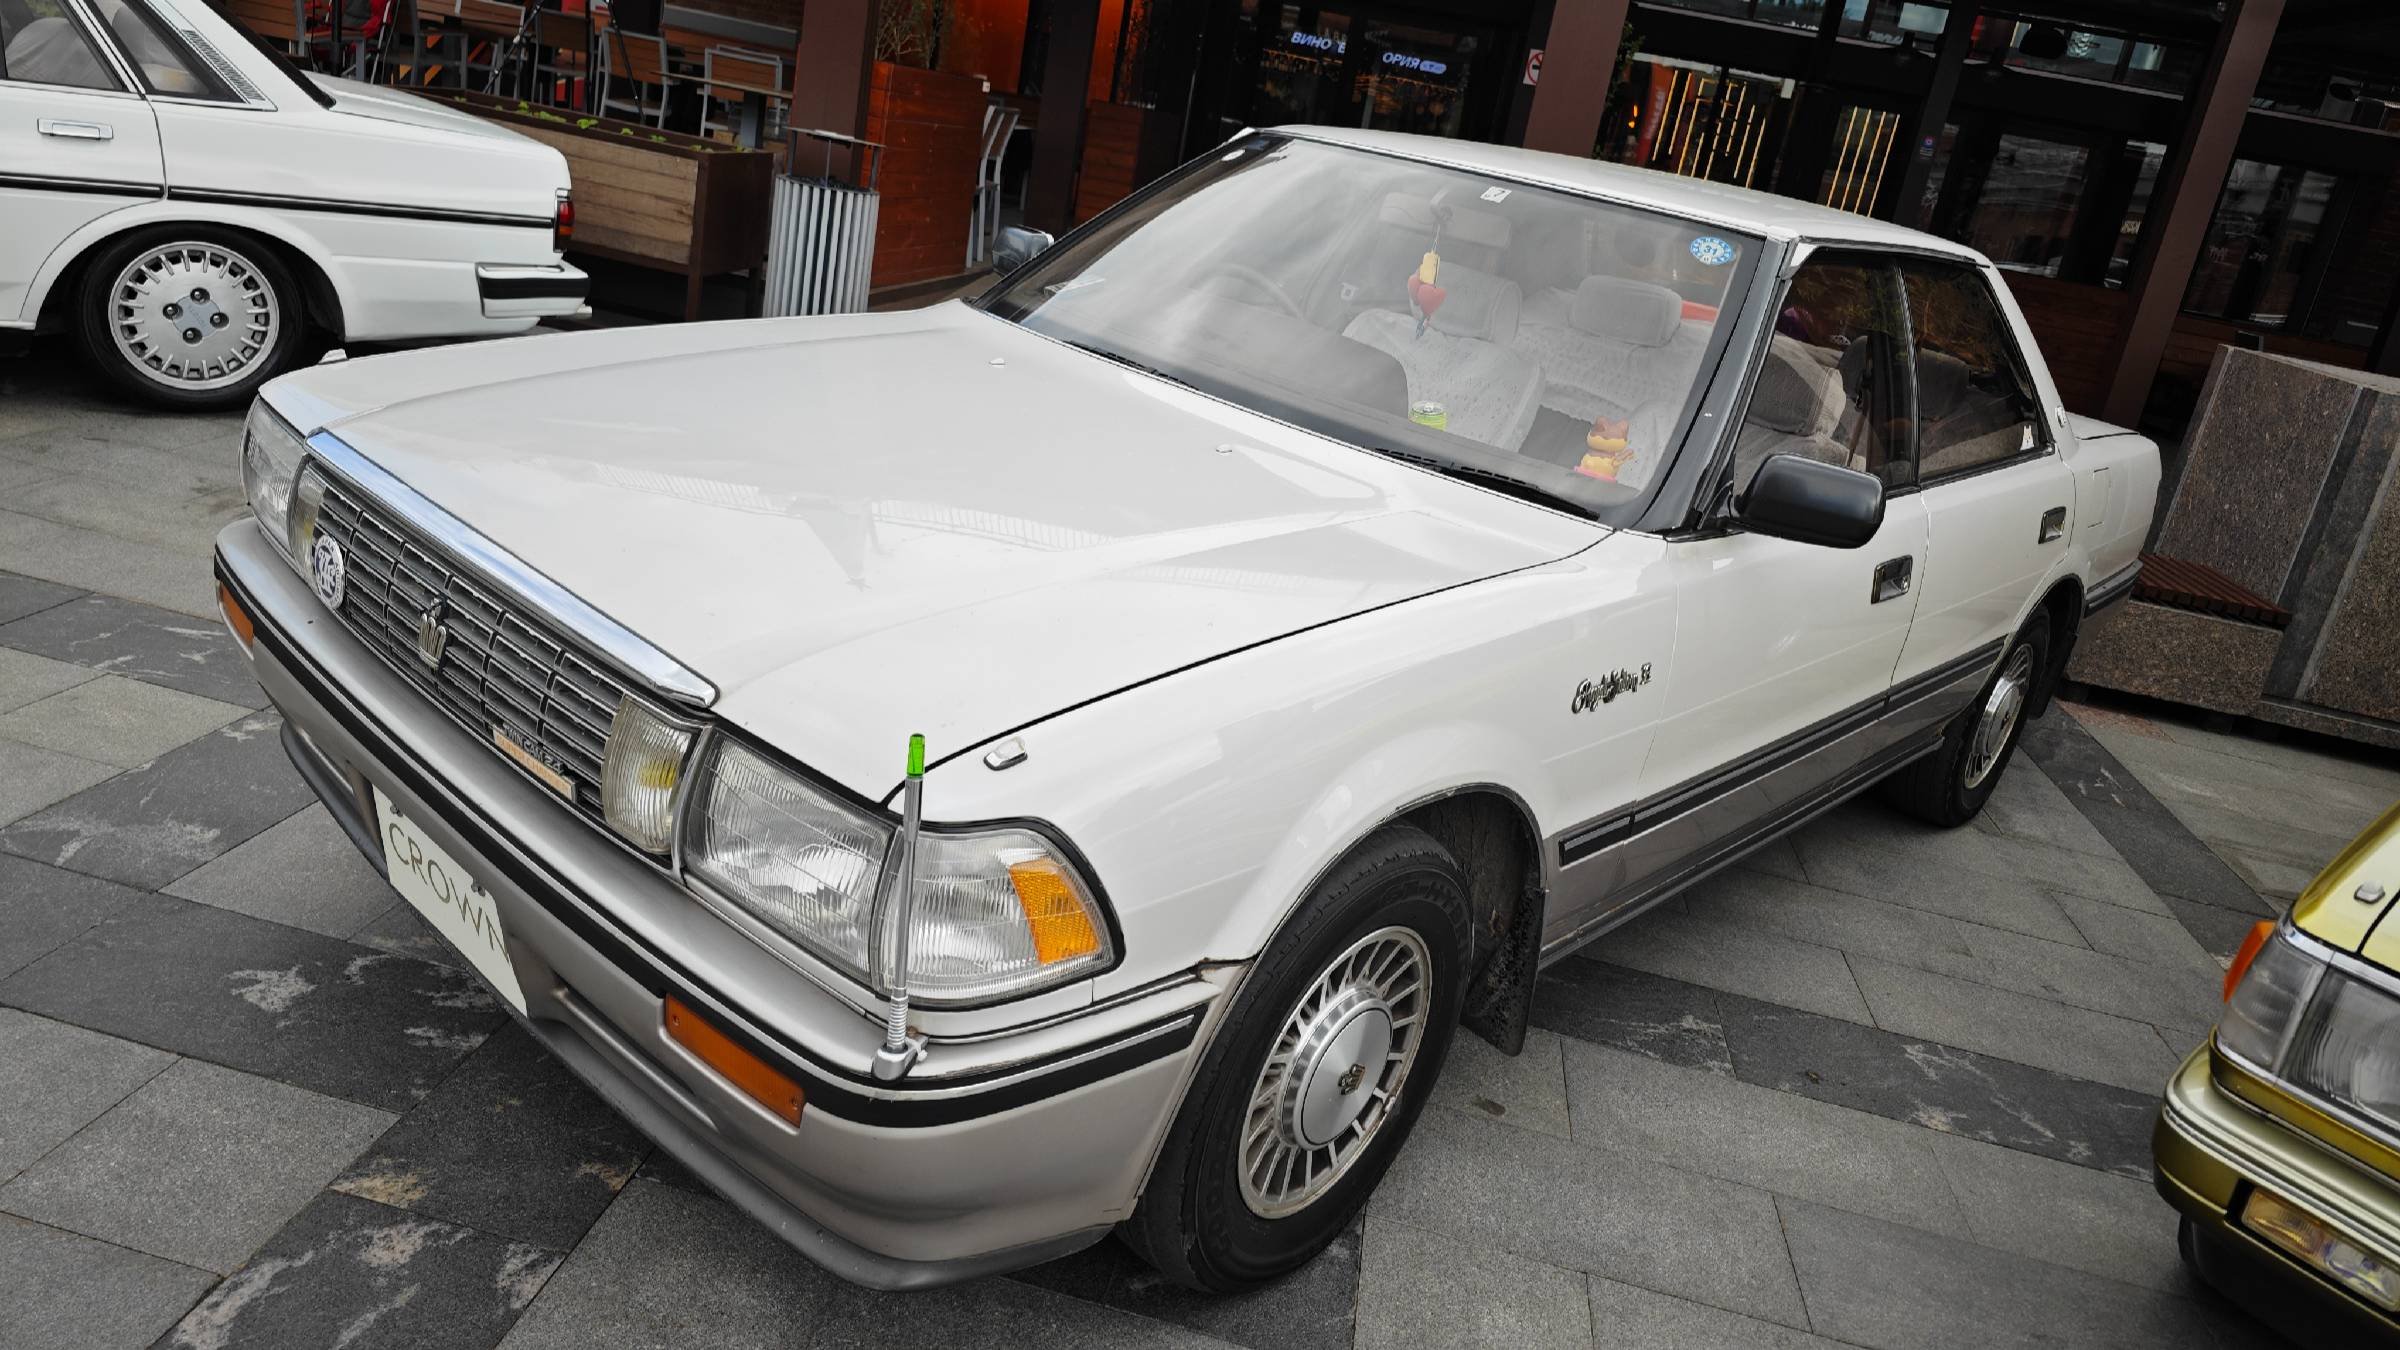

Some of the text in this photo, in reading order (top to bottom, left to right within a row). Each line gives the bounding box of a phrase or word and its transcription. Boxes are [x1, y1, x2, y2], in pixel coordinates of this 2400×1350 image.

[1290, 31, 1332, 50] ВИНО
[502, 722, 524, 749] TWIN
[523, 740, 543, 763] CAM
[388, 822, 511, 965] CROWN
